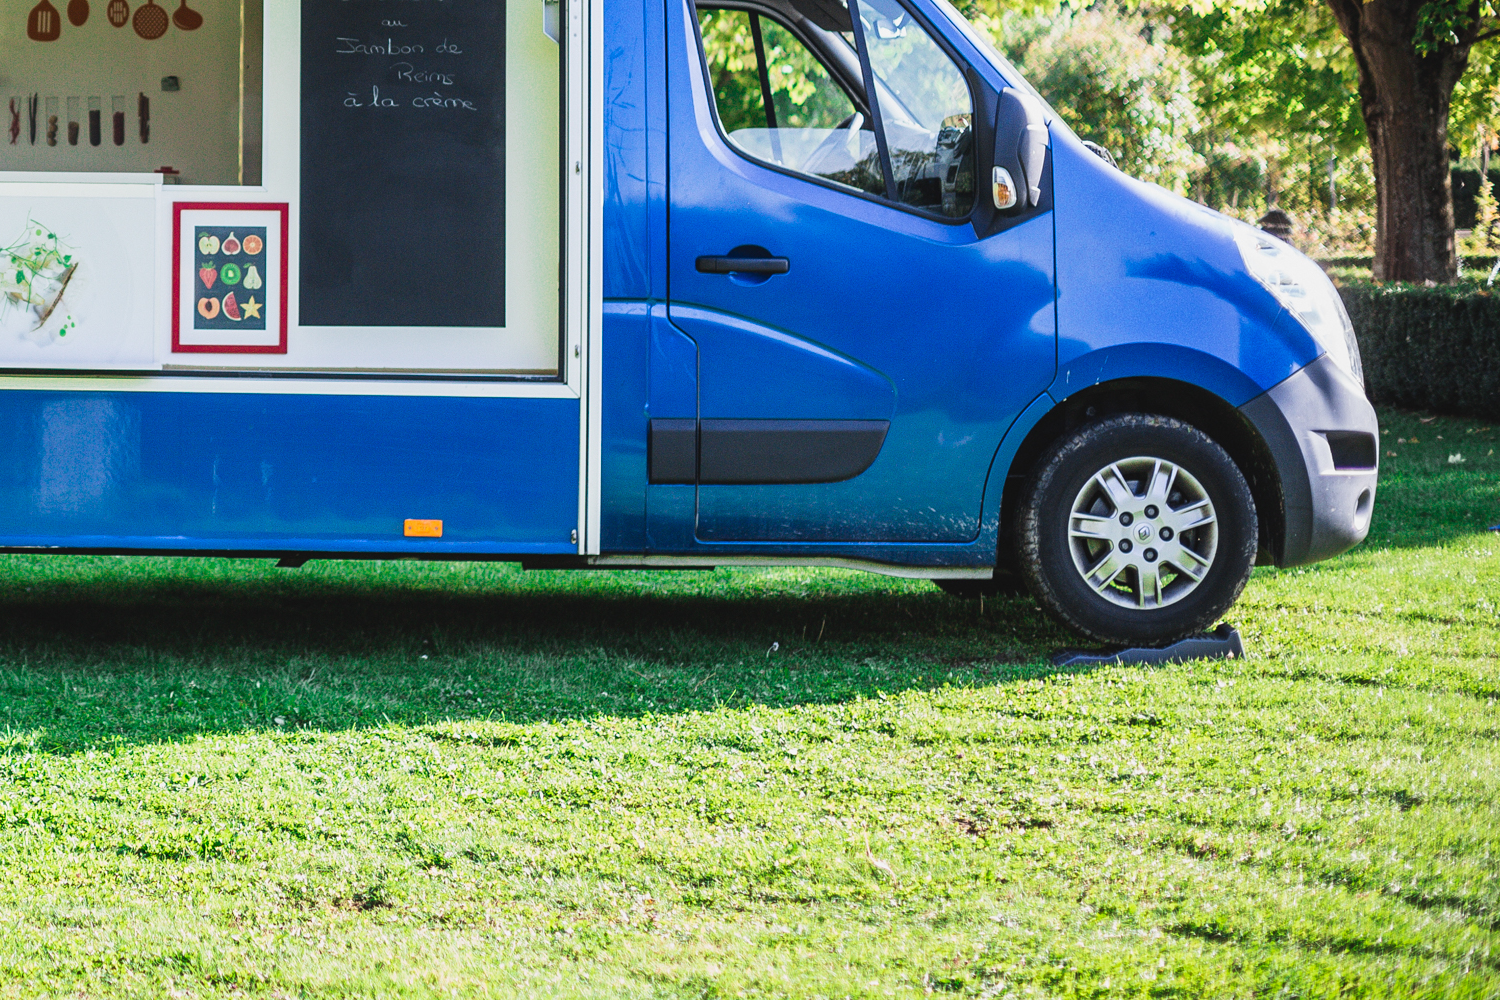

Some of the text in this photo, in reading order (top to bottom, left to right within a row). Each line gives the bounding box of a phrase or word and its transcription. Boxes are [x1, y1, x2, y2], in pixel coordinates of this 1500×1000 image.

[381, 19, 408, 27] au
[336, 37, 463, 55] Jambon de
[389, 61, 455, 85] Reims
[343, 84, 478, 111] à la crème
